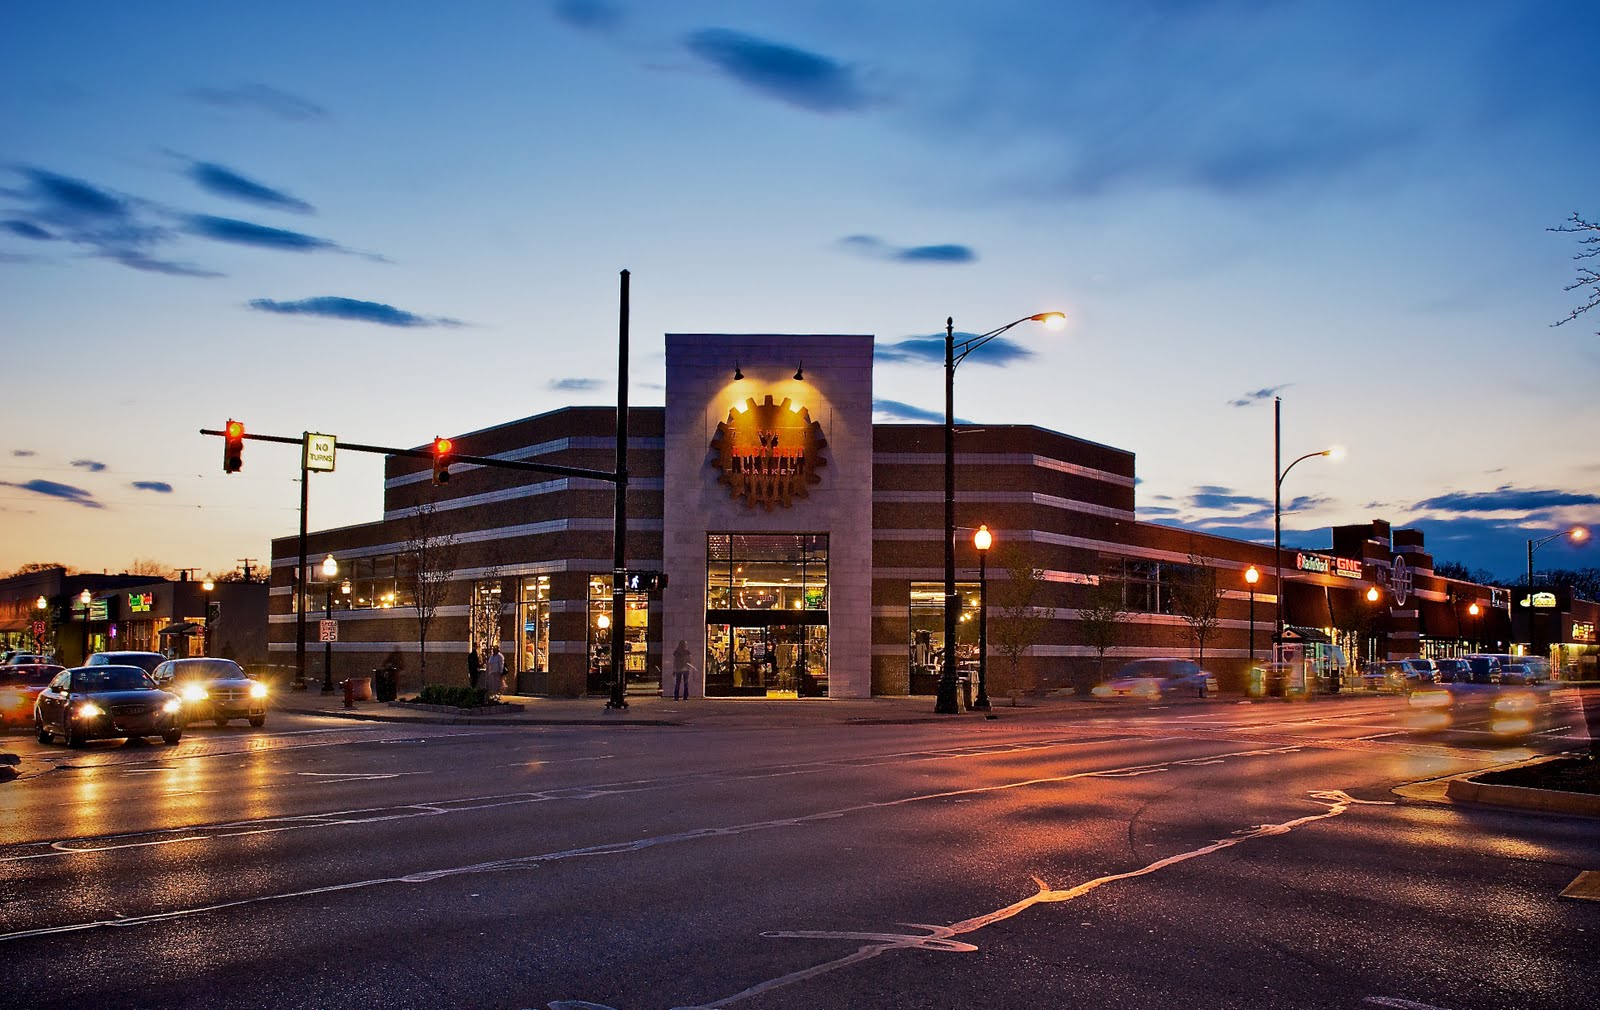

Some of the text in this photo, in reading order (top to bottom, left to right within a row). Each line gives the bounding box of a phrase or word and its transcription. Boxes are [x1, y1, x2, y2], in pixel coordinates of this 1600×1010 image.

[316, 443, 328, 452] NO
[733, 446, 803, 457] RUST BELT
[310, 453, 332, 462] TURNS
[1337, 558, 1362, 572] GNC
[322, 632, 336, 640] 25
